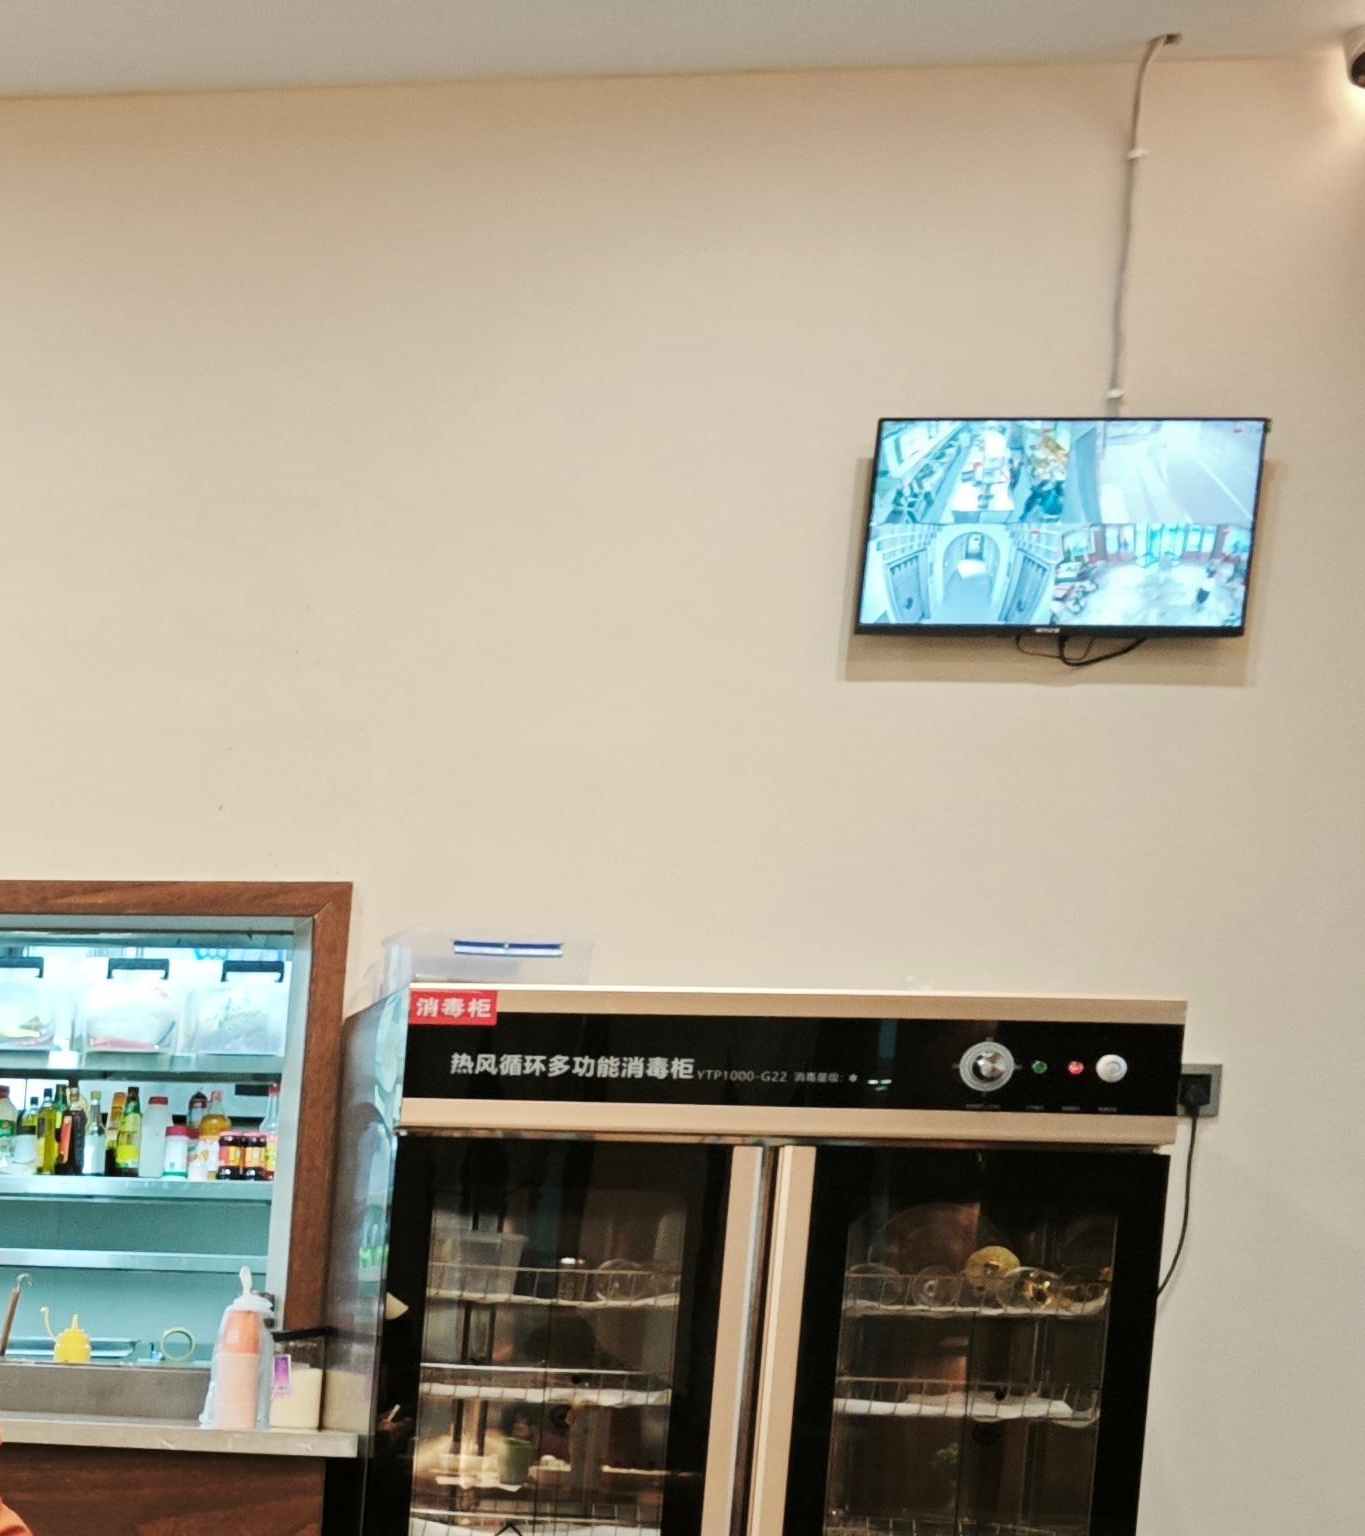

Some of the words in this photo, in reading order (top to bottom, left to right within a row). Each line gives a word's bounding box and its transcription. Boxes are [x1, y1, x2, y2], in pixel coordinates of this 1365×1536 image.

[416, 997, 492, 1018] 消毒柜
[450, 1052, 695, 1080] 热风循环多功能消毒柜
[697, 1069, 788, 1083] YTP1000-G22
